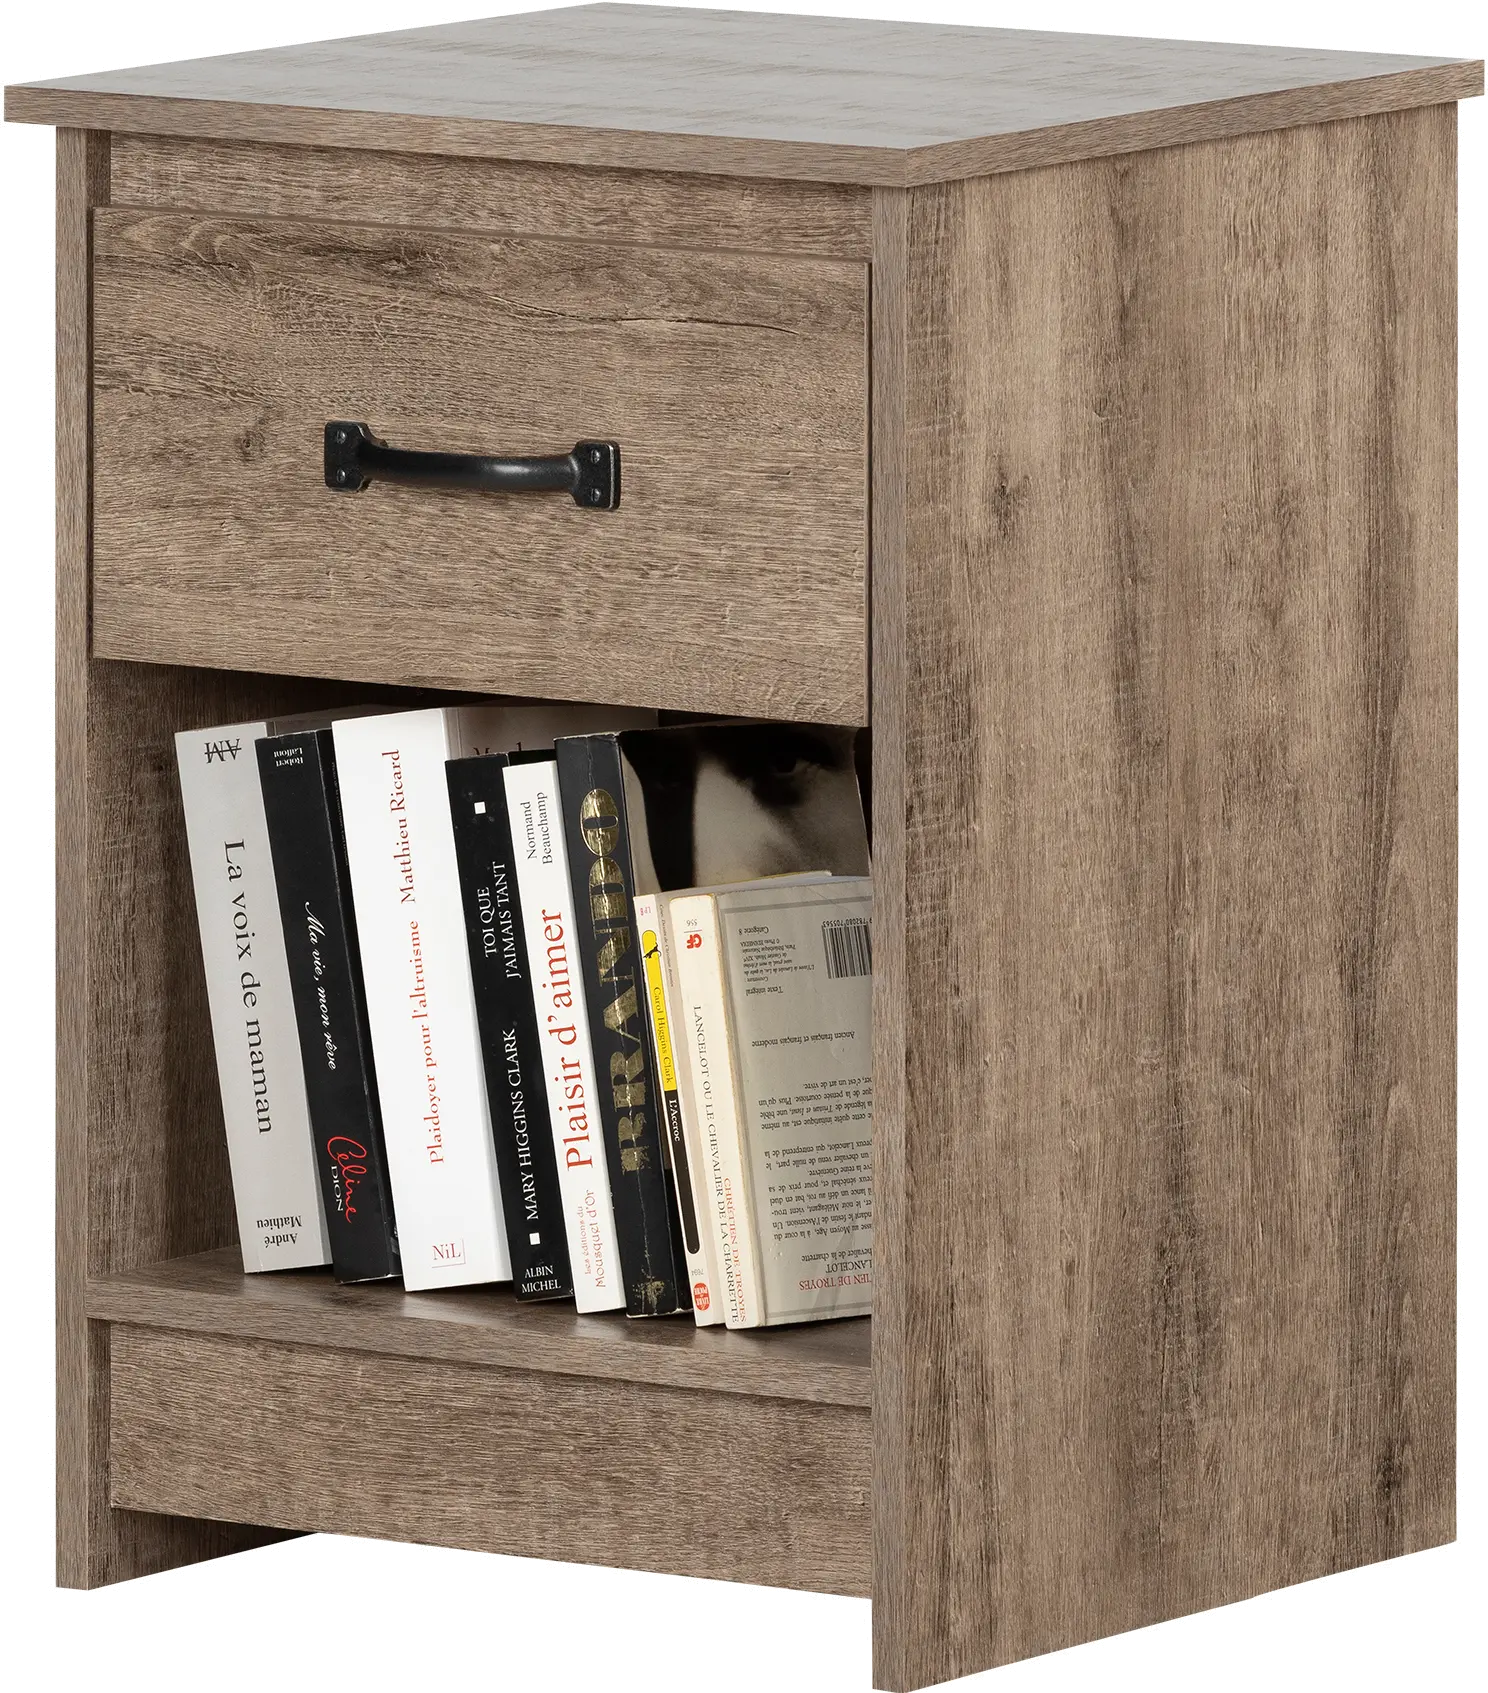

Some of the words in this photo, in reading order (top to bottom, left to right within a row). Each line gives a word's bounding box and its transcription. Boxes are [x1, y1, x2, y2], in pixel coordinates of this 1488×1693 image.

[204, 739, 242, 763] AM
[382, 750, 406, 813] Ricard
[520, 800, 537, 860] Normand
[536, 792, 553, 865] Beauchamp
[224, 839, 245, 882] La
[394, 817, 416, 904] Matthieu
[492, 861, 509, 907] TANT
[477, 887, 495, 924] QUE
[232, 891, 255, 961] voix
[305, 902, 326, 944] Ma
[744, 925, 769, 935] Catégorie
[482, 927, 497, 958] TOI
[498, 909, 522, 978] J'AIMAIS
[687, 934, 702, 949] GF
[312, 949, 326, 981] vie,
[409, 920, 427, 1019] l'altruisme
[542, 909, 578, 1045] d'aimer
[241, 972, 261, 1008] de
[746, 985, 766, 997] intégral
[767, 986, 783, 994] Texte
[318, 986, 330, 1028] mon
[654, 987, 664, 1016] Carol
[658, 1017, 667, 1054] Higgins
[694, 1006, 709, 1075] LANCELOT
[779, 1035, 802, 1046] français
[803, 1035, 809, 1044] et
[810, 1033, 833, 1043] français
[834, 1031, 855, 1039] Ancien
[421, 1024, 438, 1068] pour
[751, 1039, 778, 1048] moderne
[324, 1031, 337, 1070] rêve
[502, 1028, 521, 1087] CLARK
[246, 1018, 272, 1134] maman
[663, 1056, 674, 1084] Clark
[702, 1080, 712, 1100] OU
[803, 1082, 819, 1091] vivre.
[820, 1081, 828, 1090] de
[824, 1090, 843, 1101] pensée
[845, 1091, 851, 1099] la
[853, 1090, 860, 1098] de
[779, 1097, 792, 1105] Plus
[844, 1100, 866, 1111] légende
[554, 1056, 593, 1171] Plaisir
[706, 1104, 714, 1120] LE
[835, 1104, 843, 1112] de
[424, 1075, 444, 1165] Plaidoyer
[669, 1099, 681, 1142] L'Accroc
[760, 1111, 775, 1120] bible
[511, 1091, 532, 1168] HIGGINS
[761, 1122, 780, 1131] même
[764, 1151, 770, 1159] la
[772, 1150, 780, 1158] de
[782, 1146, 814, 1156] entreprend
[815, 1144, 825, 1153] qui
[708, 1124, 724, 1197] CHEVALIER
[809, 1158, 816, 1166] de
[834, 1153, 859, 1164] chevalier
[766, 1162, 771, 1170] le
[840, 1165, 855, 1174] reine
[331, 1166, 344, 1211] DION
[778, 1185, 786, 1193] de
[789, 1182, 802, 1191] prix
[804, 1180, 818, 1188] pour
[520, 1170, 539, 1220] MARY
[585, 1190, 597, 1218] d'Or
[770, 1198, 783, 1206] duel
[842, 1202, 853, 1210] noir
[577, 1206, 584, 1218] du
[718, 1201, 727, 1219] DE
[789, 1207, 804, 1215] vient
[256, 1215, 302, 1230] Mathieu
[822, 1216, 829, 1225] de
[848, 1213, 853, 1221] le
[720, 1221, 729, 1240] LA
[772, 1222, 783, 1230] Un
[830, 1225, 850, 1234] Moyen
[264, 1233, 298, 1248] André
[774, 1234, 782, 1242] du
[433, 1242, 461, 1261] NiL
[801, 1252, 829, 1262] charrette
[831, 1252, 836, 1260] la
[838, 1250, 846, 1259] de
[848, 1248, 872, 1258] hevalier
[733, 1251, 741, 1268] DE
[524, 1265, 553, 1278] ALBIN
[825, 1260, 872, 1273] LANCELOT
[522, 1279, 561, 1293] MICHEL
[723, 1244, 739, 1323] CHARRETTE
[799, 1276, 836, 1291] TROYES
[838, 1276, 851, 1287] DE
[854, 1274, 872, 1285] IEN
[735, 1271, 746, 1322] TROYES
